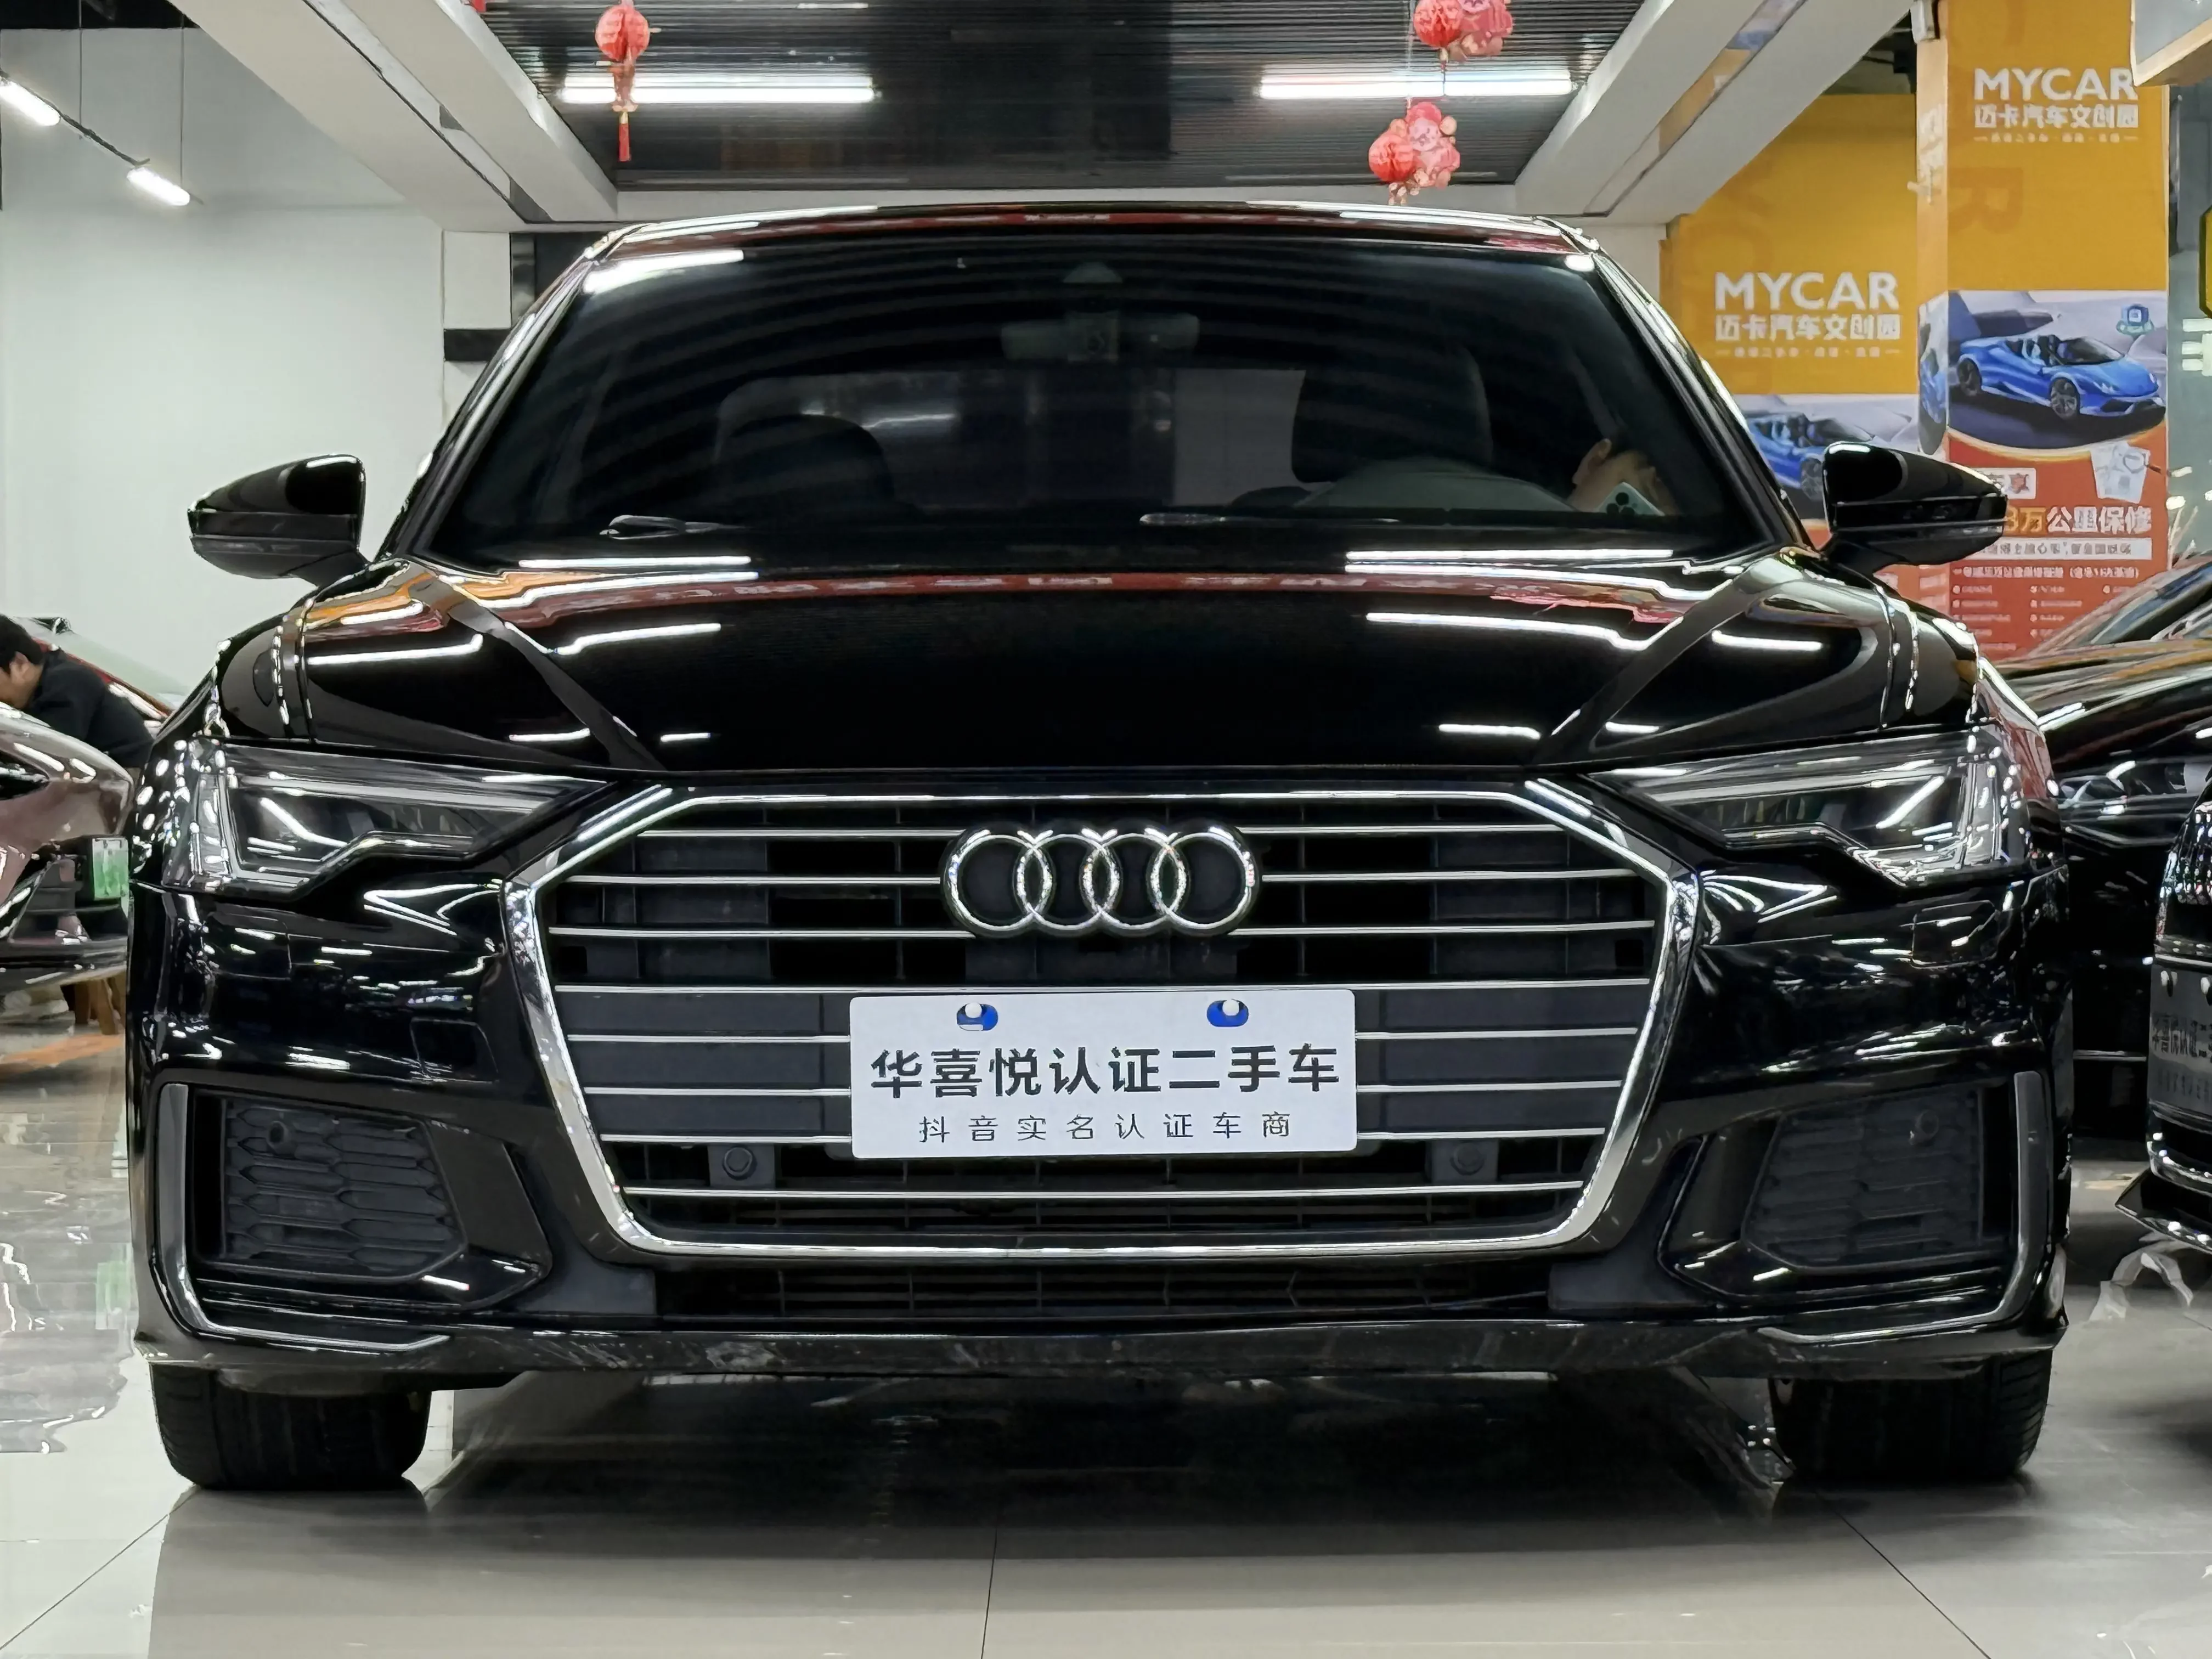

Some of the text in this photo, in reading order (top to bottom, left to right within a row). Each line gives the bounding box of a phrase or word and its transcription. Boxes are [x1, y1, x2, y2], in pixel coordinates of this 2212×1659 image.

[1974, 67, 2138, 101] MYCAR
[1715, 271, 1899, 311] MYCAR
[871, 1043, 1339, 1098] 华喜悦认证二手车
[919, 1111, 1290, 1143] 抖音实名认证车商
